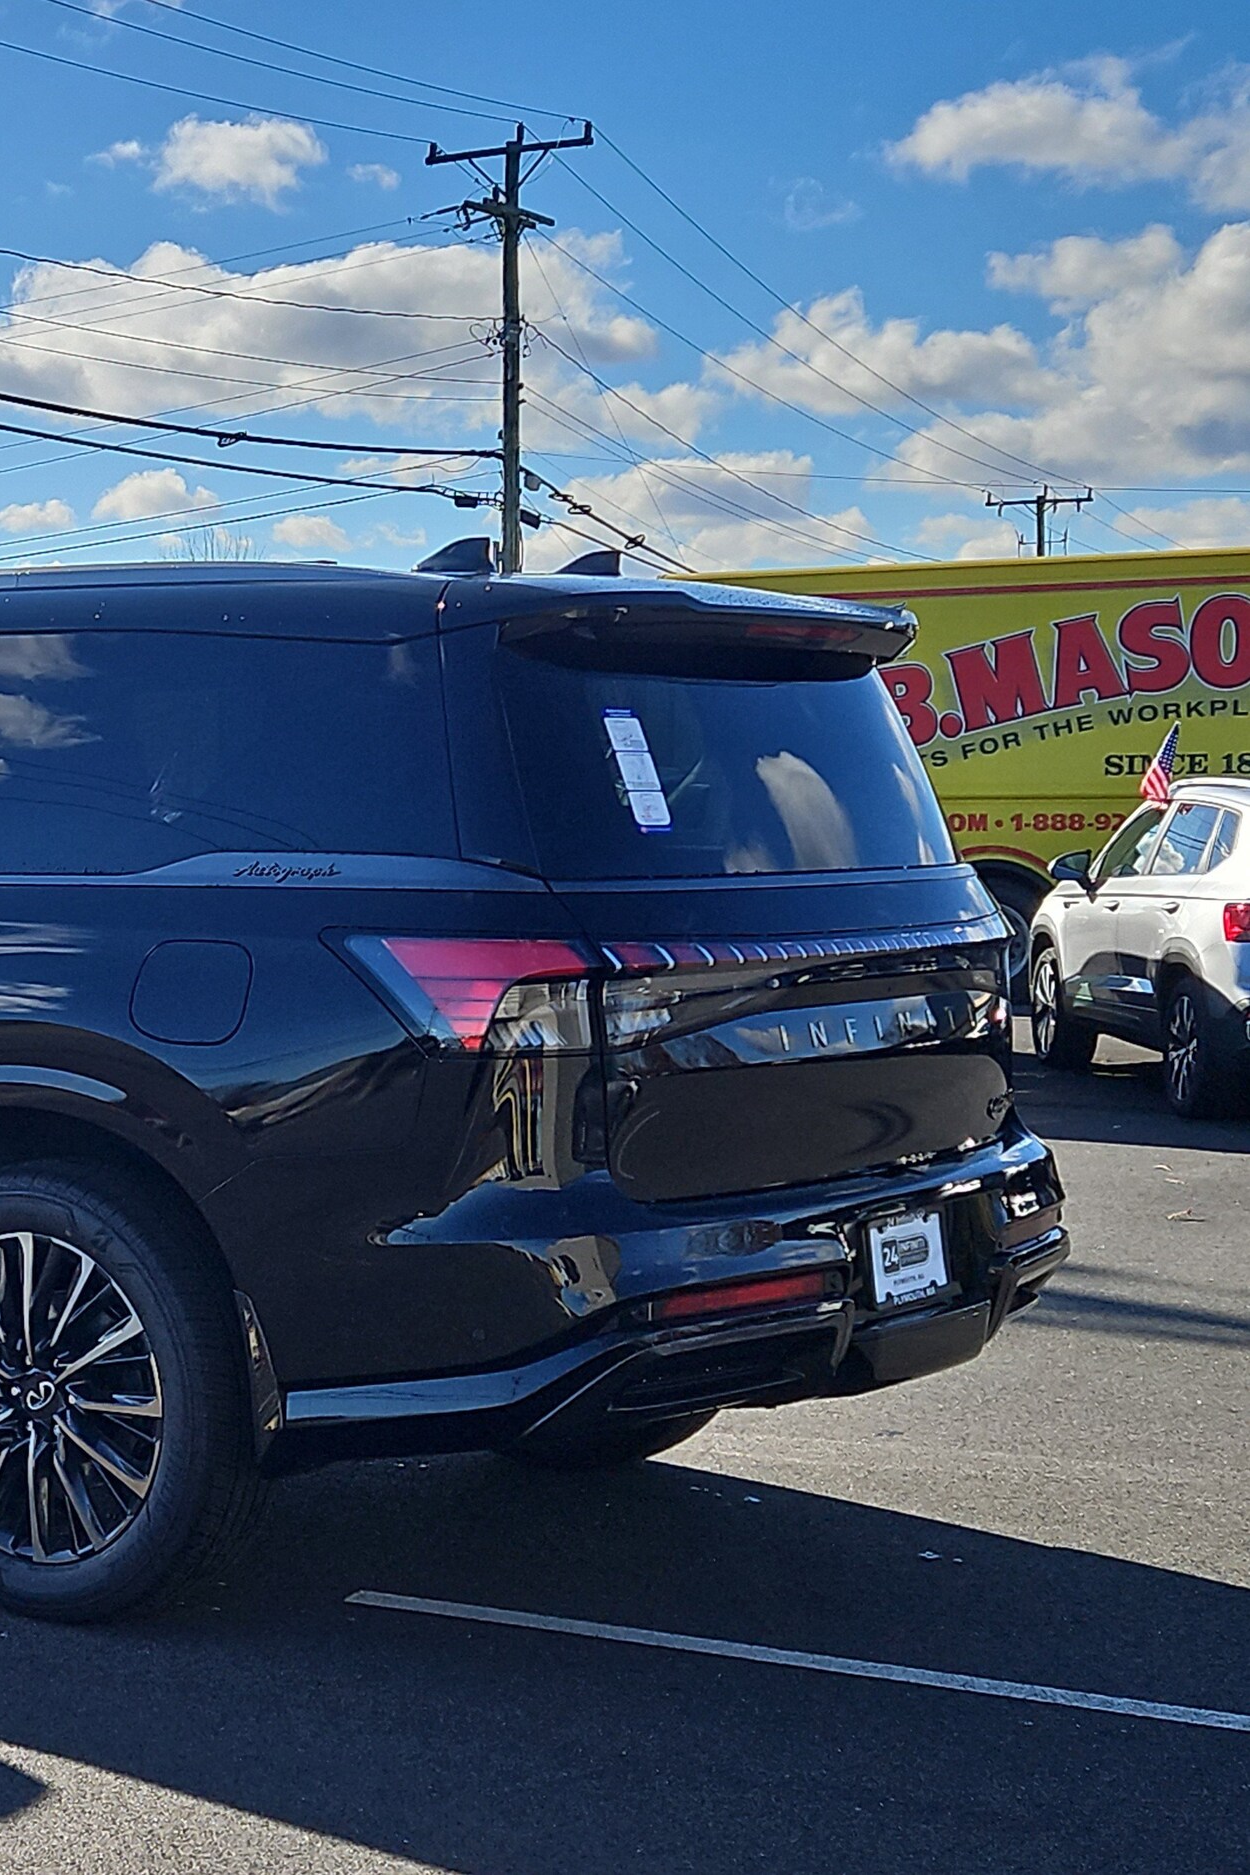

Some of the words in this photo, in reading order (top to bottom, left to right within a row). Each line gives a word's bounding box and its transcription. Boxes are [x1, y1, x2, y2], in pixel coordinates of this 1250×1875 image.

[961, 731, 1022, 760] FOR
[1033, 714, 1095, 741] THE
[1108, 699, 1249, 726] WORKPL
[232, 860, 342, 884] Autograph
[883, 1245, 899, 1268] 24
